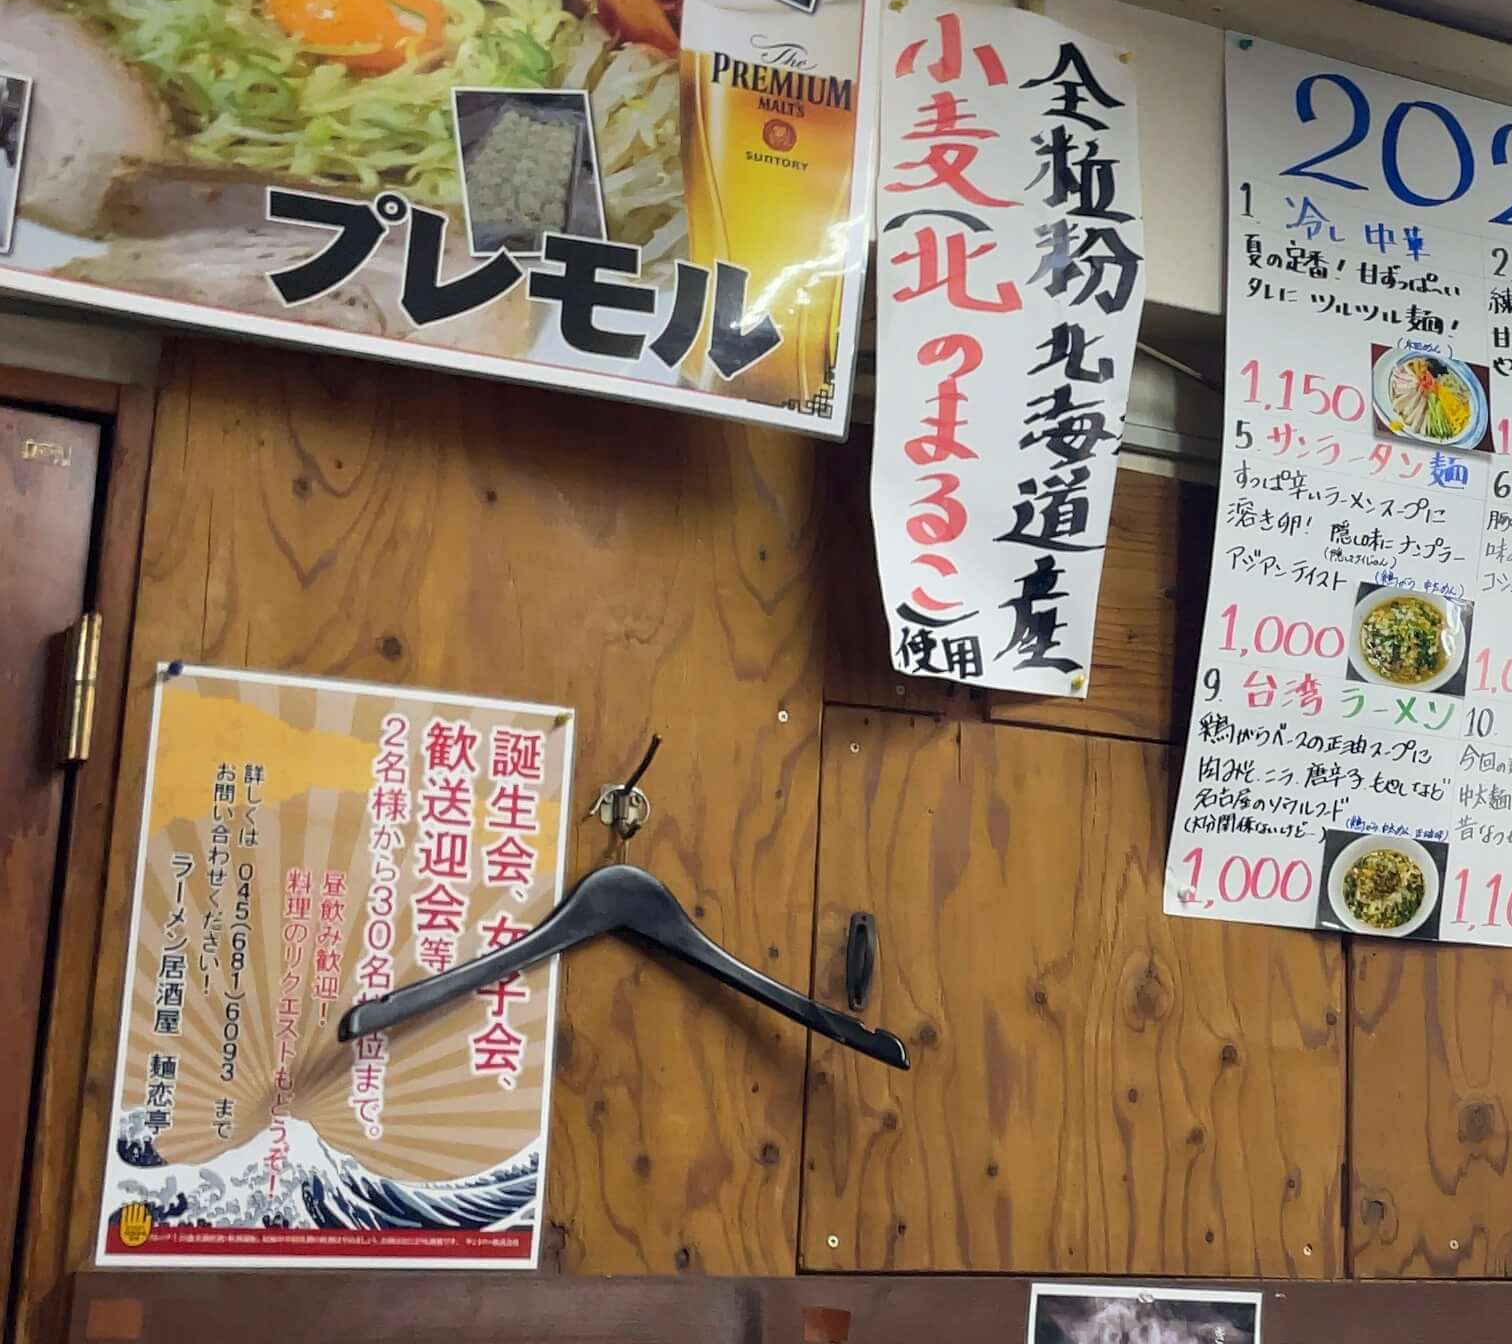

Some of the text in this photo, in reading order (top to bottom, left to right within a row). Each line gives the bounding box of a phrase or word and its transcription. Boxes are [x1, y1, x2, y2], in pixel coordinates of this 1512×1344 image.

[711, 51, 852, 112] PREMIUM
[745, 151, 809, 172] SUNTORY
[1285, 195, 1431, 263] 冷し中華
[264, 185, 783, 380] プレモル
[1246, 276, 1299, 303] タレに
[1266, 422, 1469, 490] サンラータン麺
[1224, 544, 1349, 592] アジアンテイスト
[1242, 669, 1455, 731] 台湾ラーメン
[1192, 787, 1350, 823] 名古屋のソウルフード
[197, 763, 237, 997] お問い合わせください!
[211, 763, 265, 1139] 詳しくは 045(681)6093 まで
[315, 871, 347, 1027] 昼飲み歓迎!
[351, 715, 409, 1140] 2名様から30名位まで。
[143, 854, 193, 1135] ラーメン居酒屋 麺恋亭
[265, 868, 313, 1199] 料理のリクエストもどうぞ!
